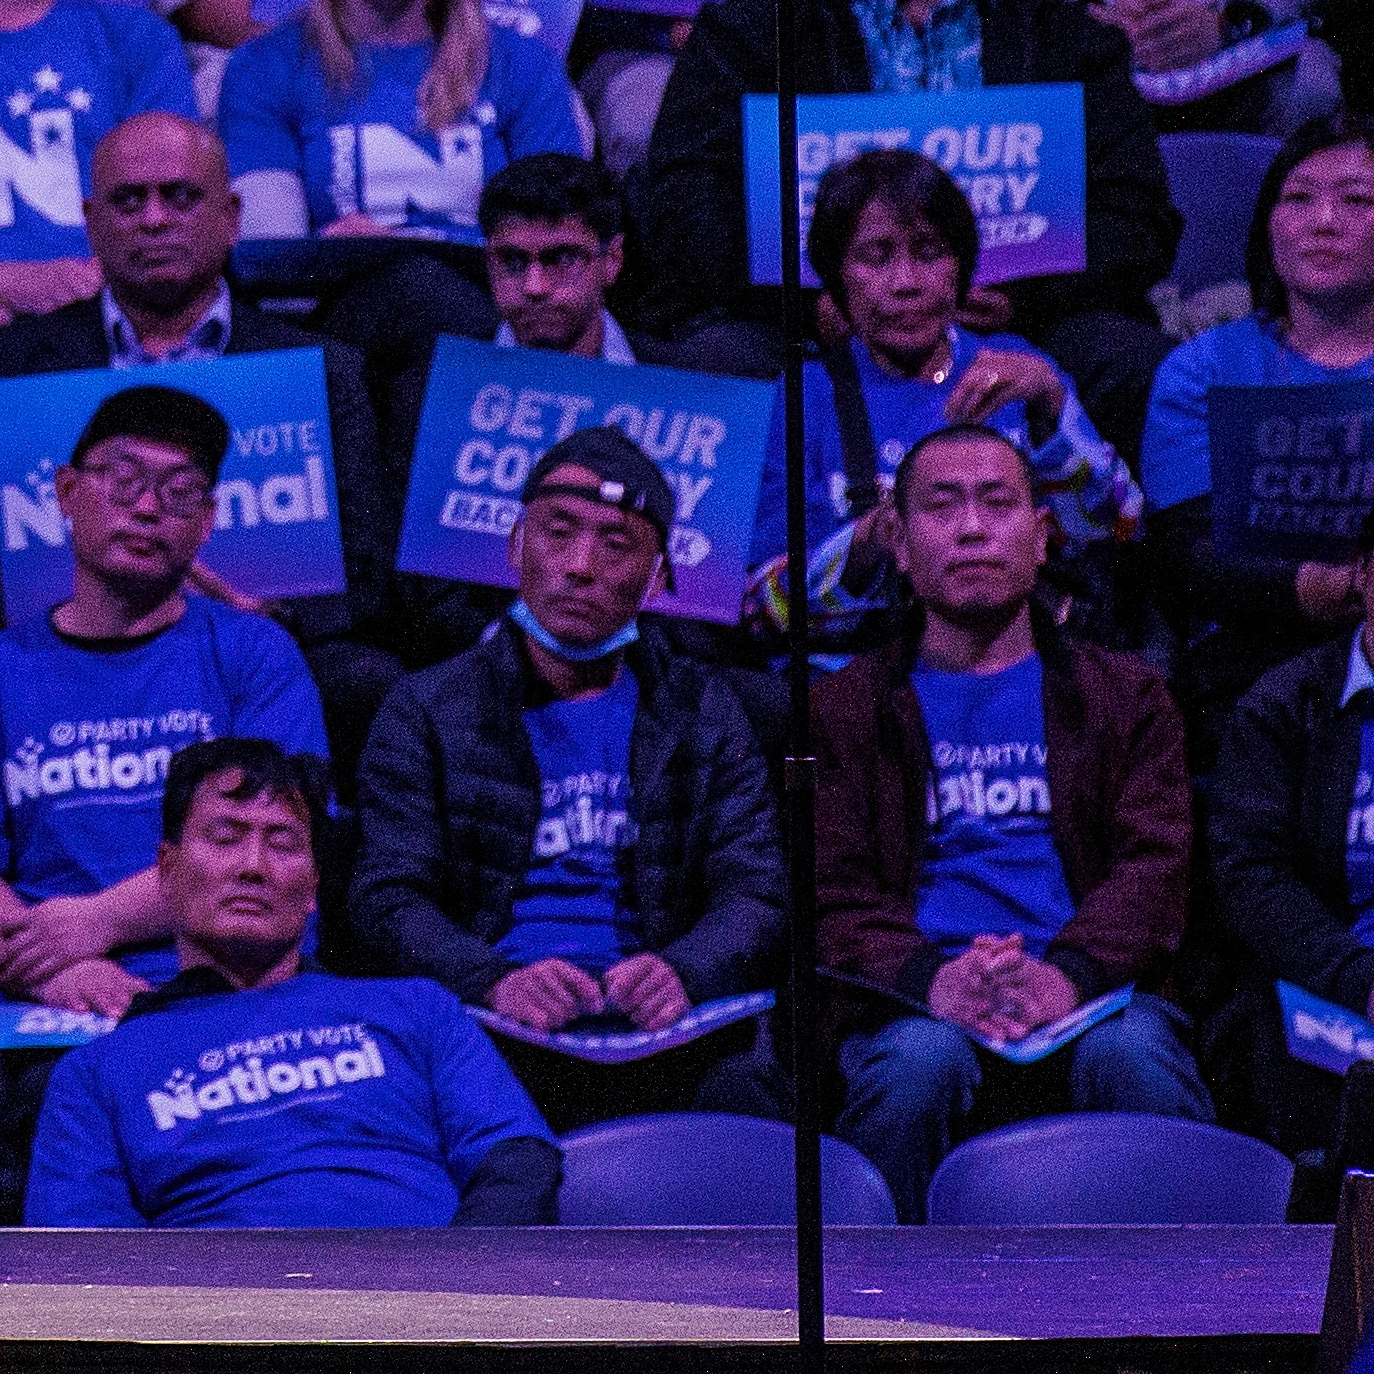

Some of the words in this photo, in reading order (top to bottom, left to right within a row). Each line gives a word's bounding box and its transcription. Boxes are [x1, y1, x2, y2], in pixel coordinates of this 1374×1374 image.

[921, 122, 1044, 171] OUR
[469, 382, 595, 444] GET
[231, 420, 319, 457] VOTE
[77, 716, 154, 743] PARTY
[3, 743, 173, 808] Nation
[954, 741, 1030, 769] PARTY
[927, 768, 1052, 824] ation
[225, 1029, 303, 1062] PARTY
[306, 1024, 370, 1047] VOTE
[147, 1038, 386, 1132] National
